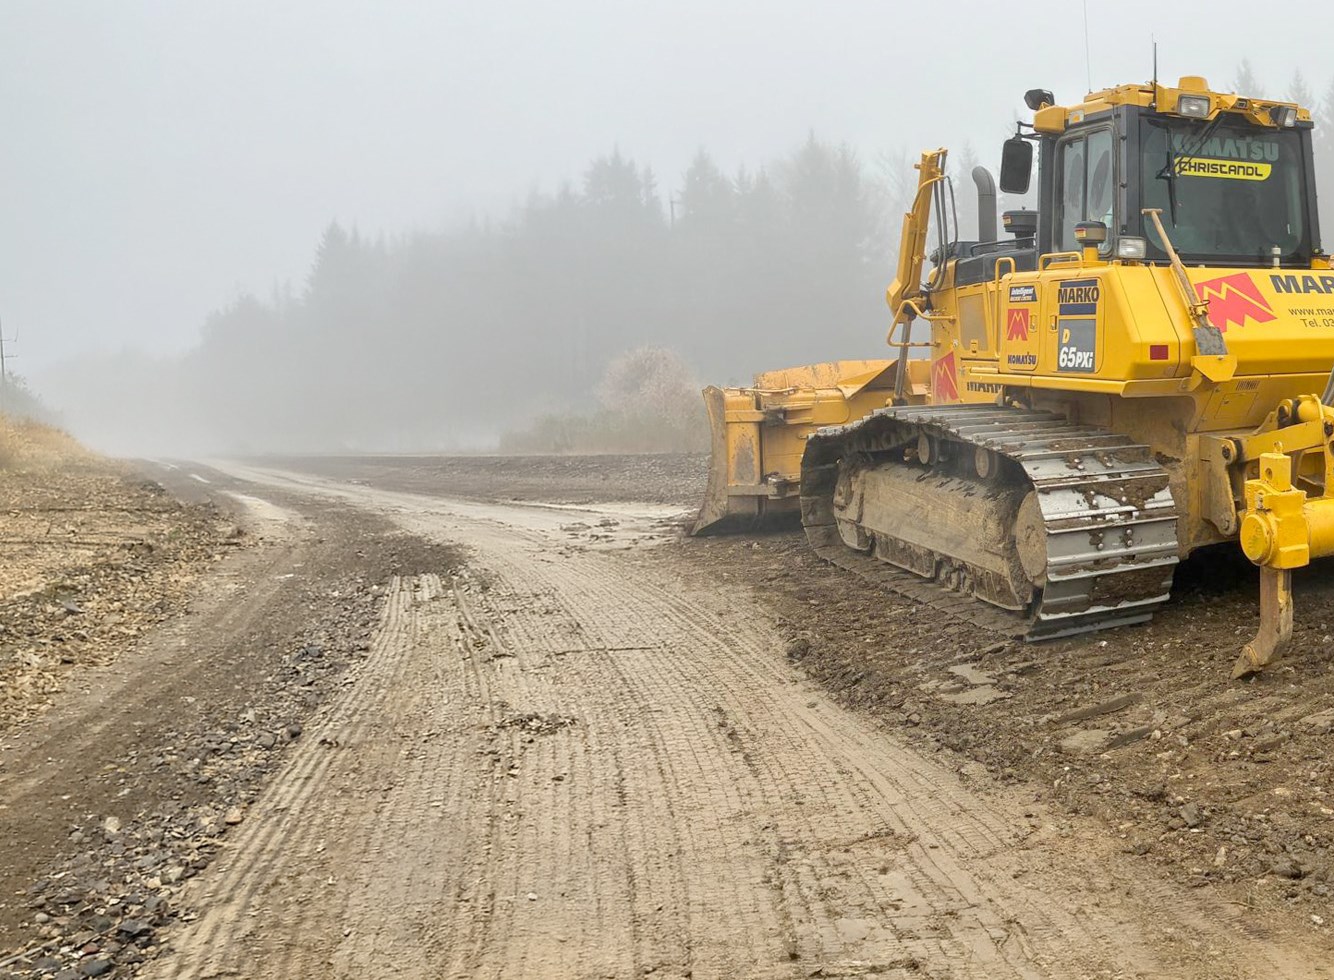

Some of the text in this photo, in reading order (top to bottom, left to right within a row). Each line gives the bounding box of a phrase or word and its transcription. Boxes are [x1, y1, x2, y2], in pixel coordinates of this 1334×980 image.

[1179, 161, 1263, 177] CHRISTANDL
[1058, 286, 1099, 303] MARKO
[1300, 318, 1321, 327] Tel.
[1062, 328, 1071, 344] D
[1008, 351, 1037, 365] KOMATSU
[1059, 346, 1094, 368] 65PXi
